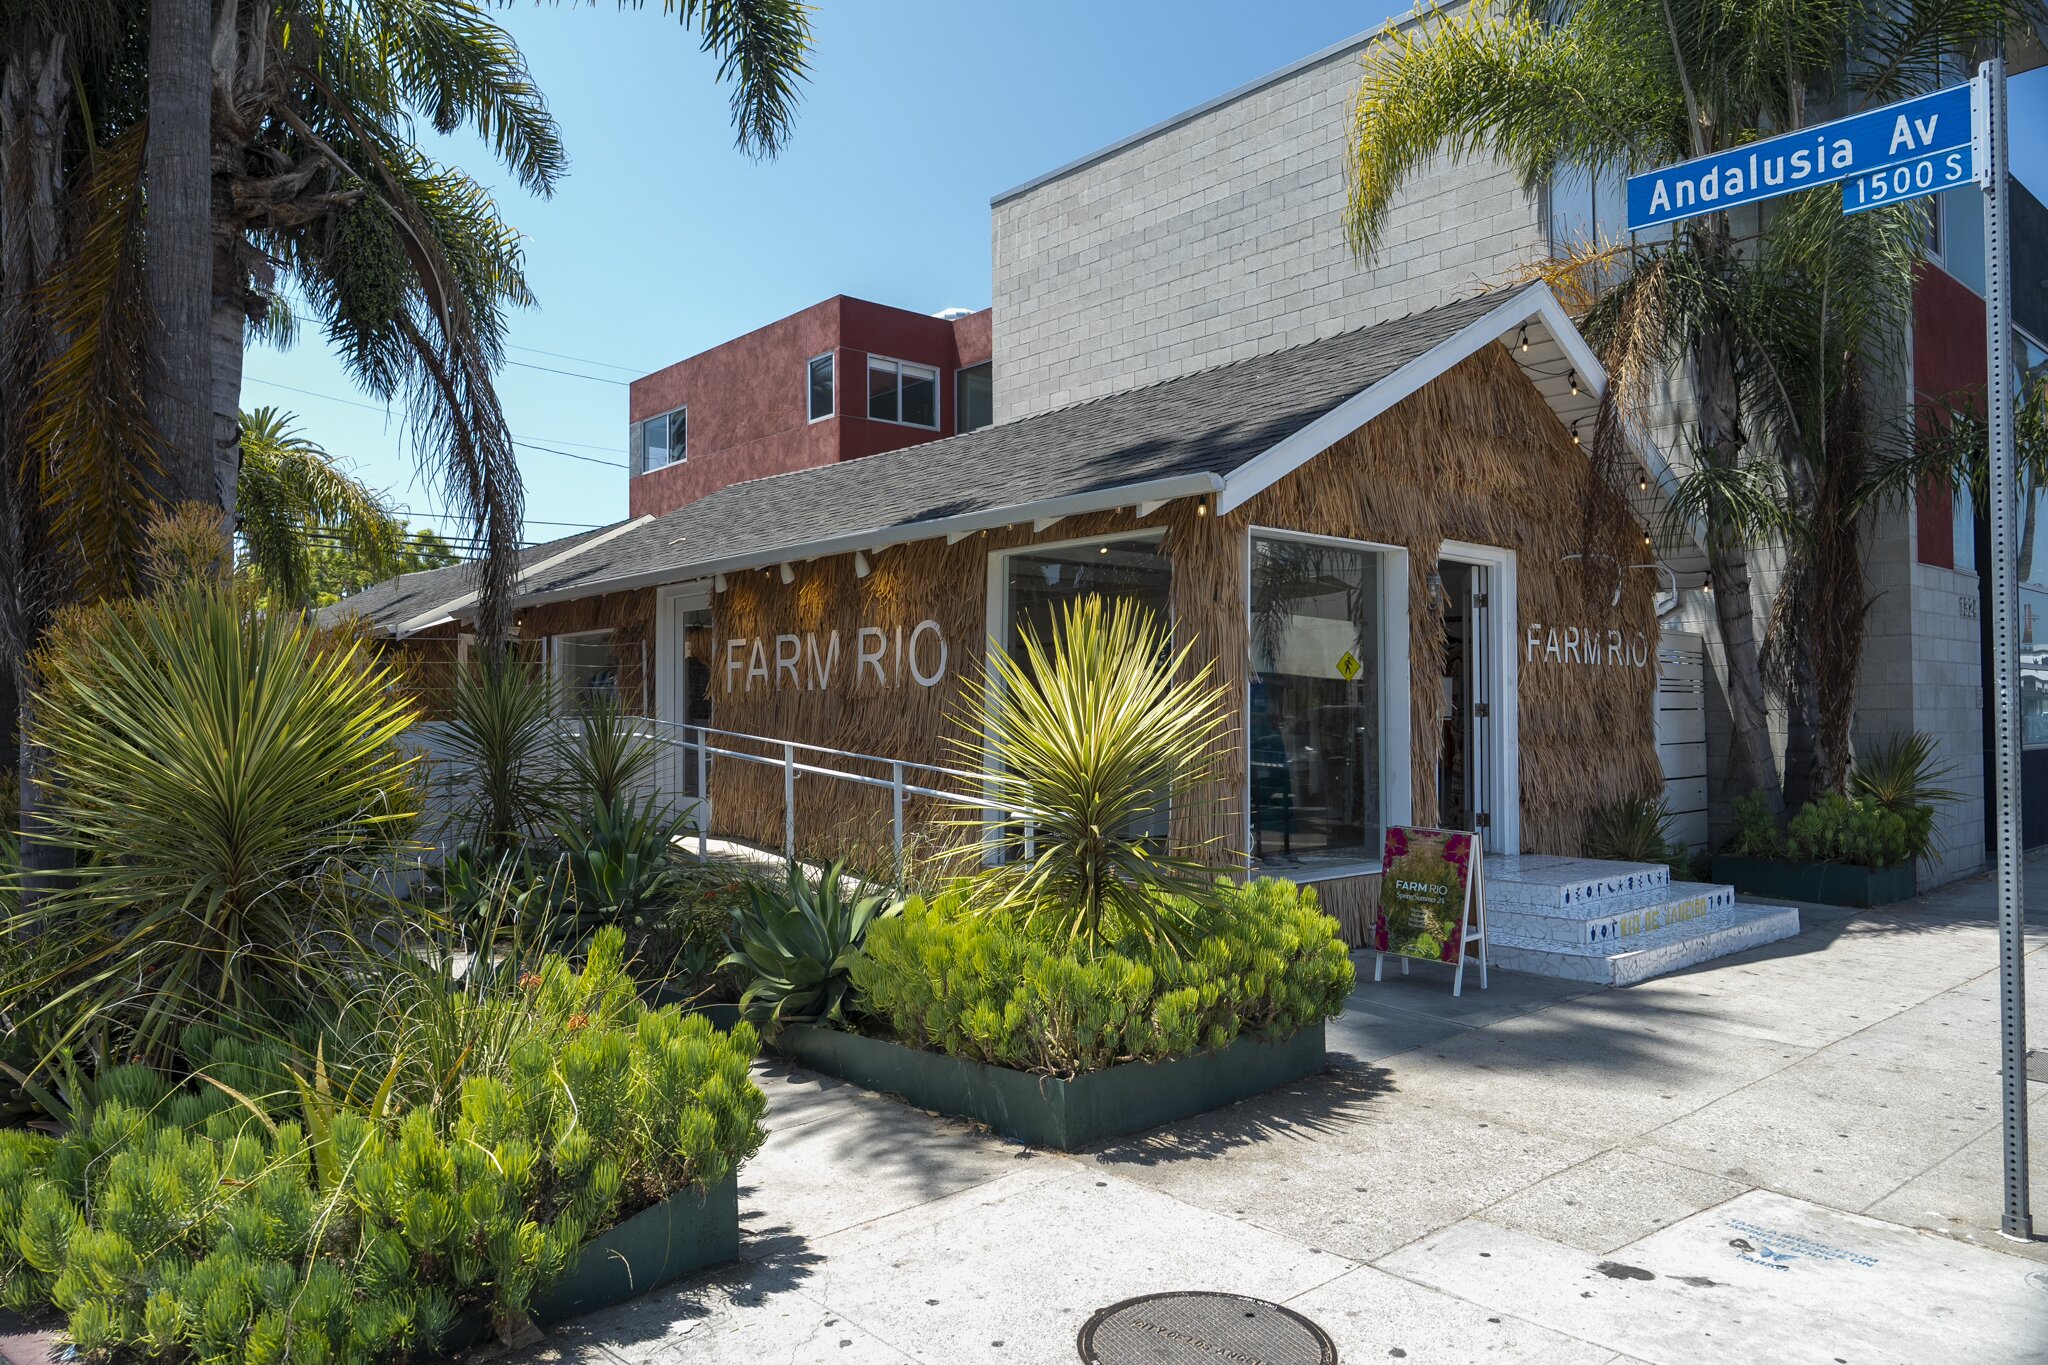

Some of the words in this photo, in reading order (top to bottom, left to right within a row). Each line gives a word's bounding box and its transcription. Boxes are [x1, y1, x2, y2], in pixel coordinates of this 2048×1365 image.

[1649, 136, 1854, 215] Andalusia
[1889, 113, 1940, 156] Av
[1856, 160, 1934, 204] 1500
[1945, 153, 1963, 181] S
[727, 629, 840, 694] FARM
[857, 619, 948, 690] RIO
[1527, 623, 1601, 666] FARM
[1608, 629, 1648, 668] RIO
[1395, 879, 1428, 893] FARM
[1429, 884, 1448, 895] RIO
[1621, 913, 1641, 937] RIO
[1645, 910, 1661, 931] DE
[1665, 896, 1707, 927] JANEIRO
[1850, 1258, 1874, 1267] ON
[1186, 1337, 1213, 1351] LOS
